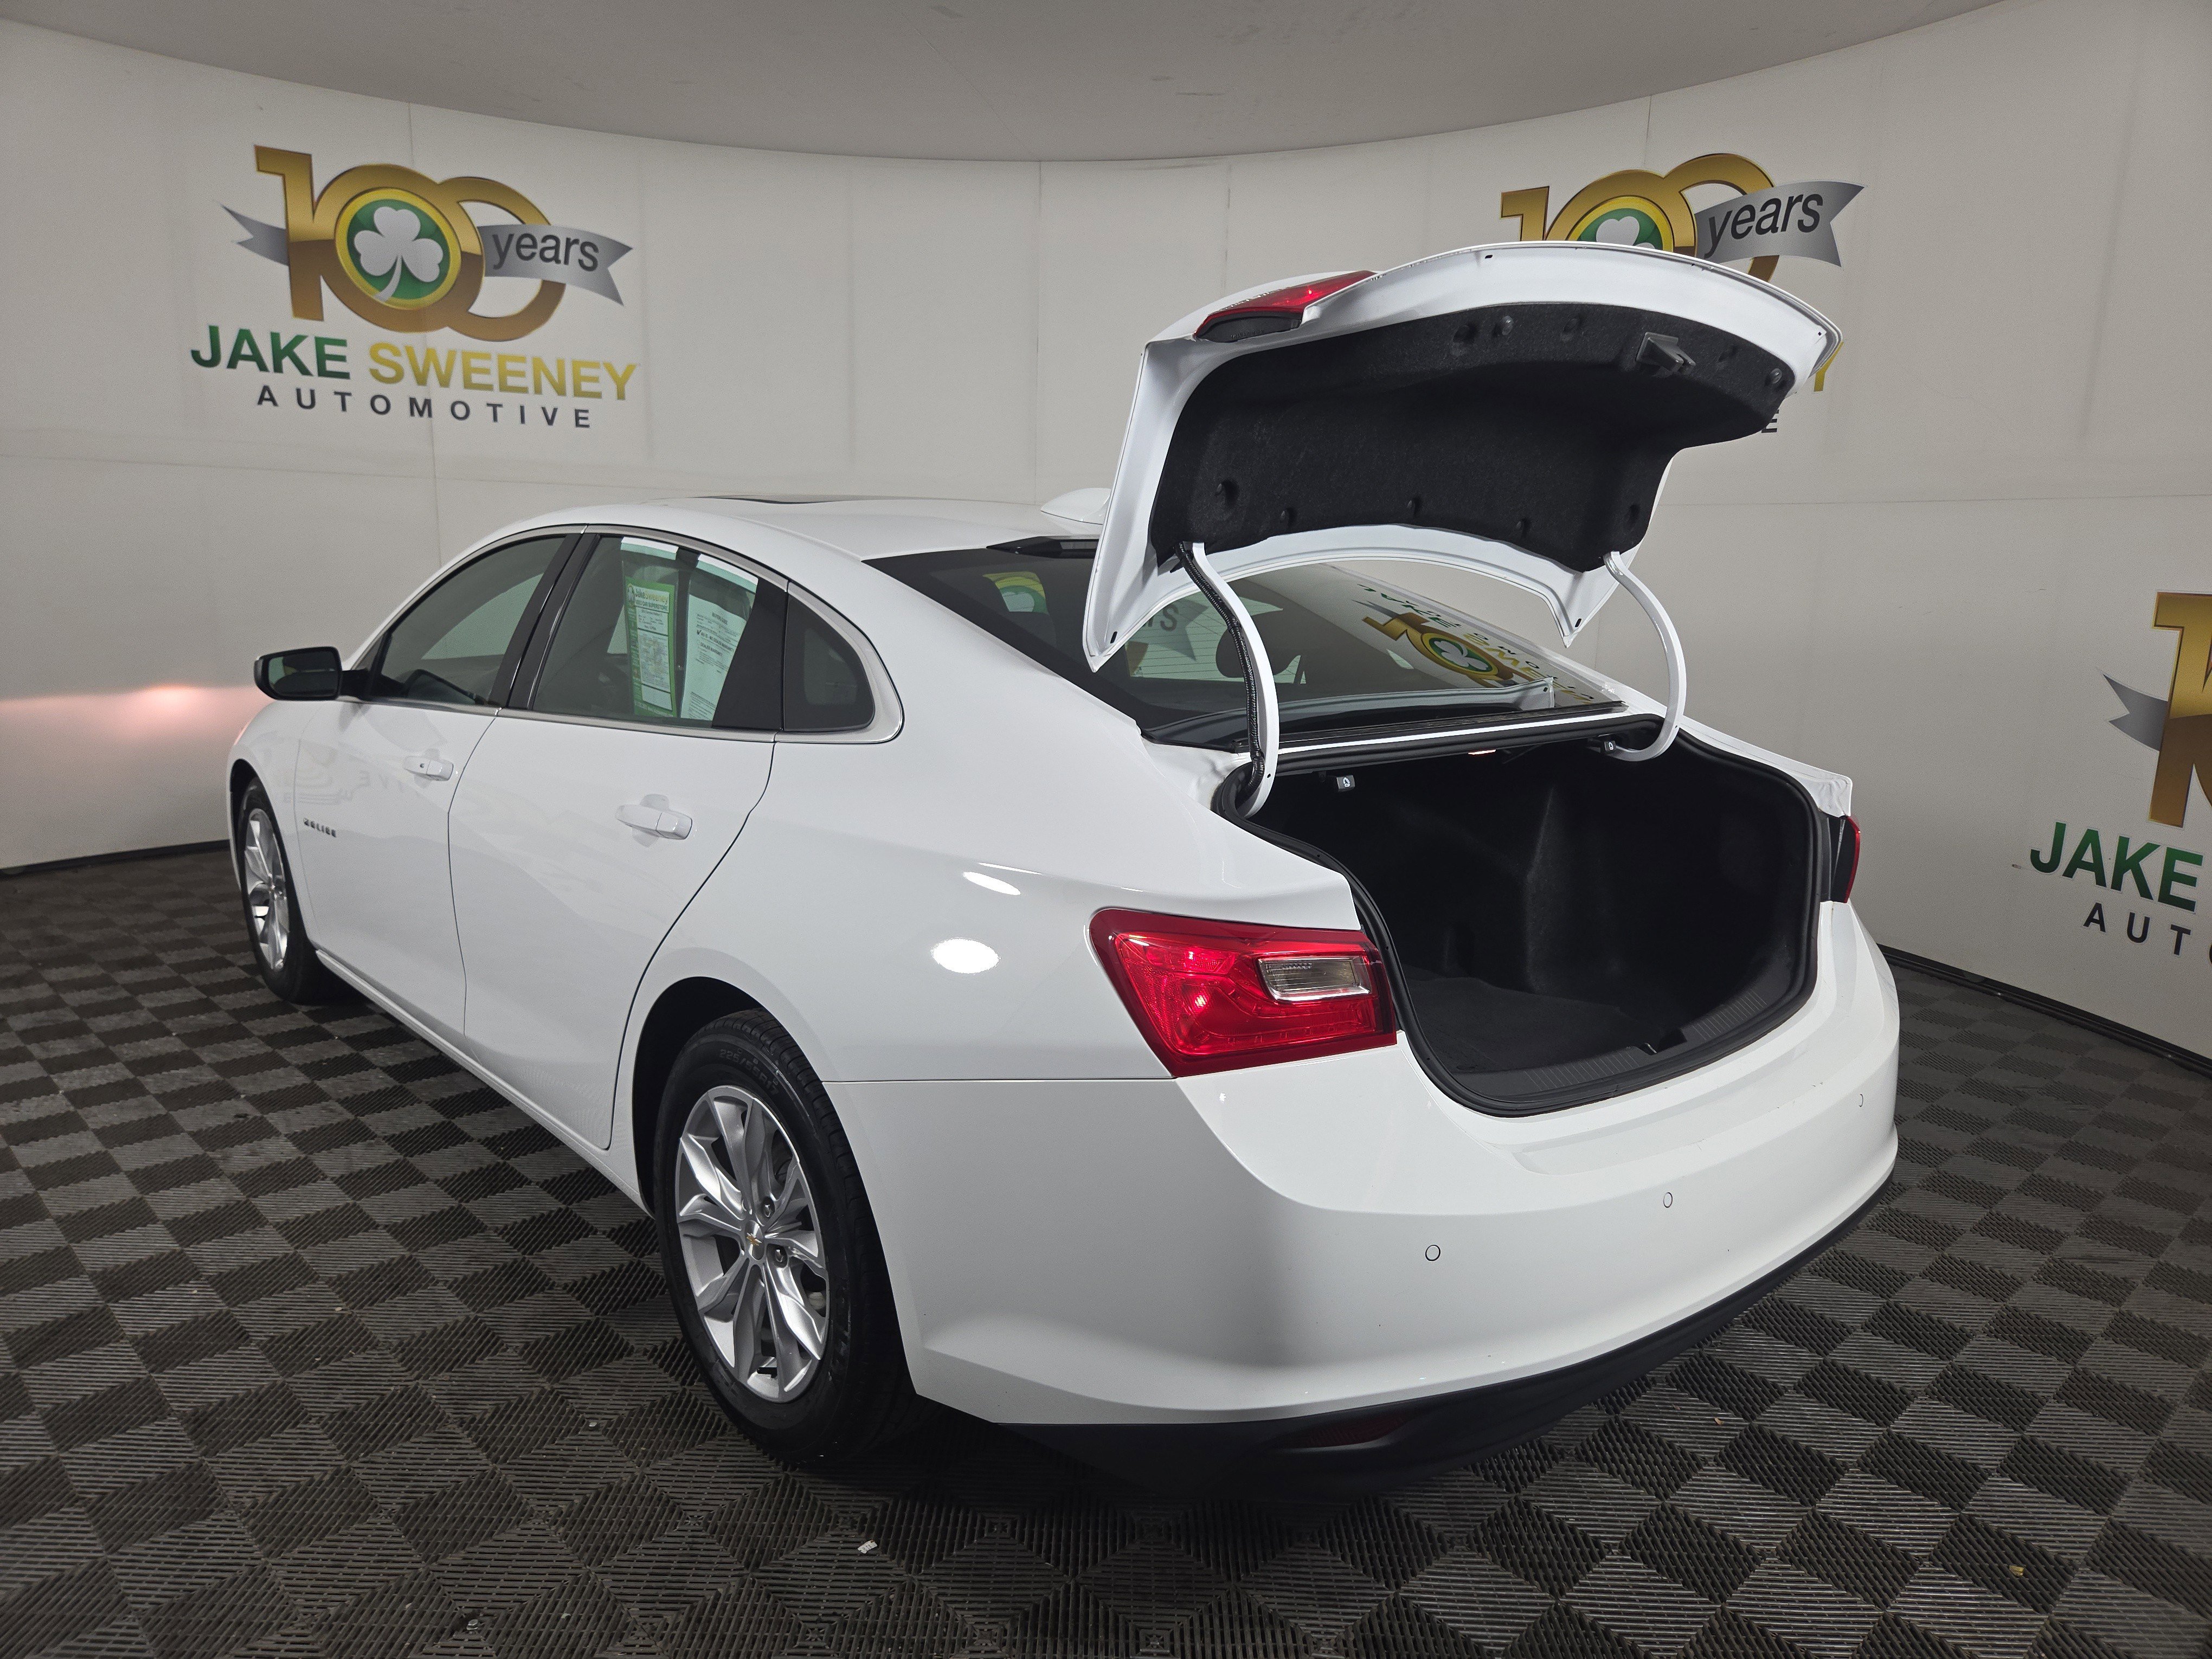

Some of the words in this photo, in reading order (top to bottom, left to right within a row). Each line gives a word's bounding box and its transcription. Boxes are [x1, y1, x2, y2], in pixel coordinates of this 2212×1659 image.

[254, 145, 566, 342] 100
[492, 230, 600, 272] years
[1705, 193, 1823, 259] years
[190, 324, 350, 380] JAKE
[369, 342, 637, 401] SWEENEY
[257, 385, 591, 428] AUTOMOTIVE
[2030, 821, 2203, 912] JAKE
